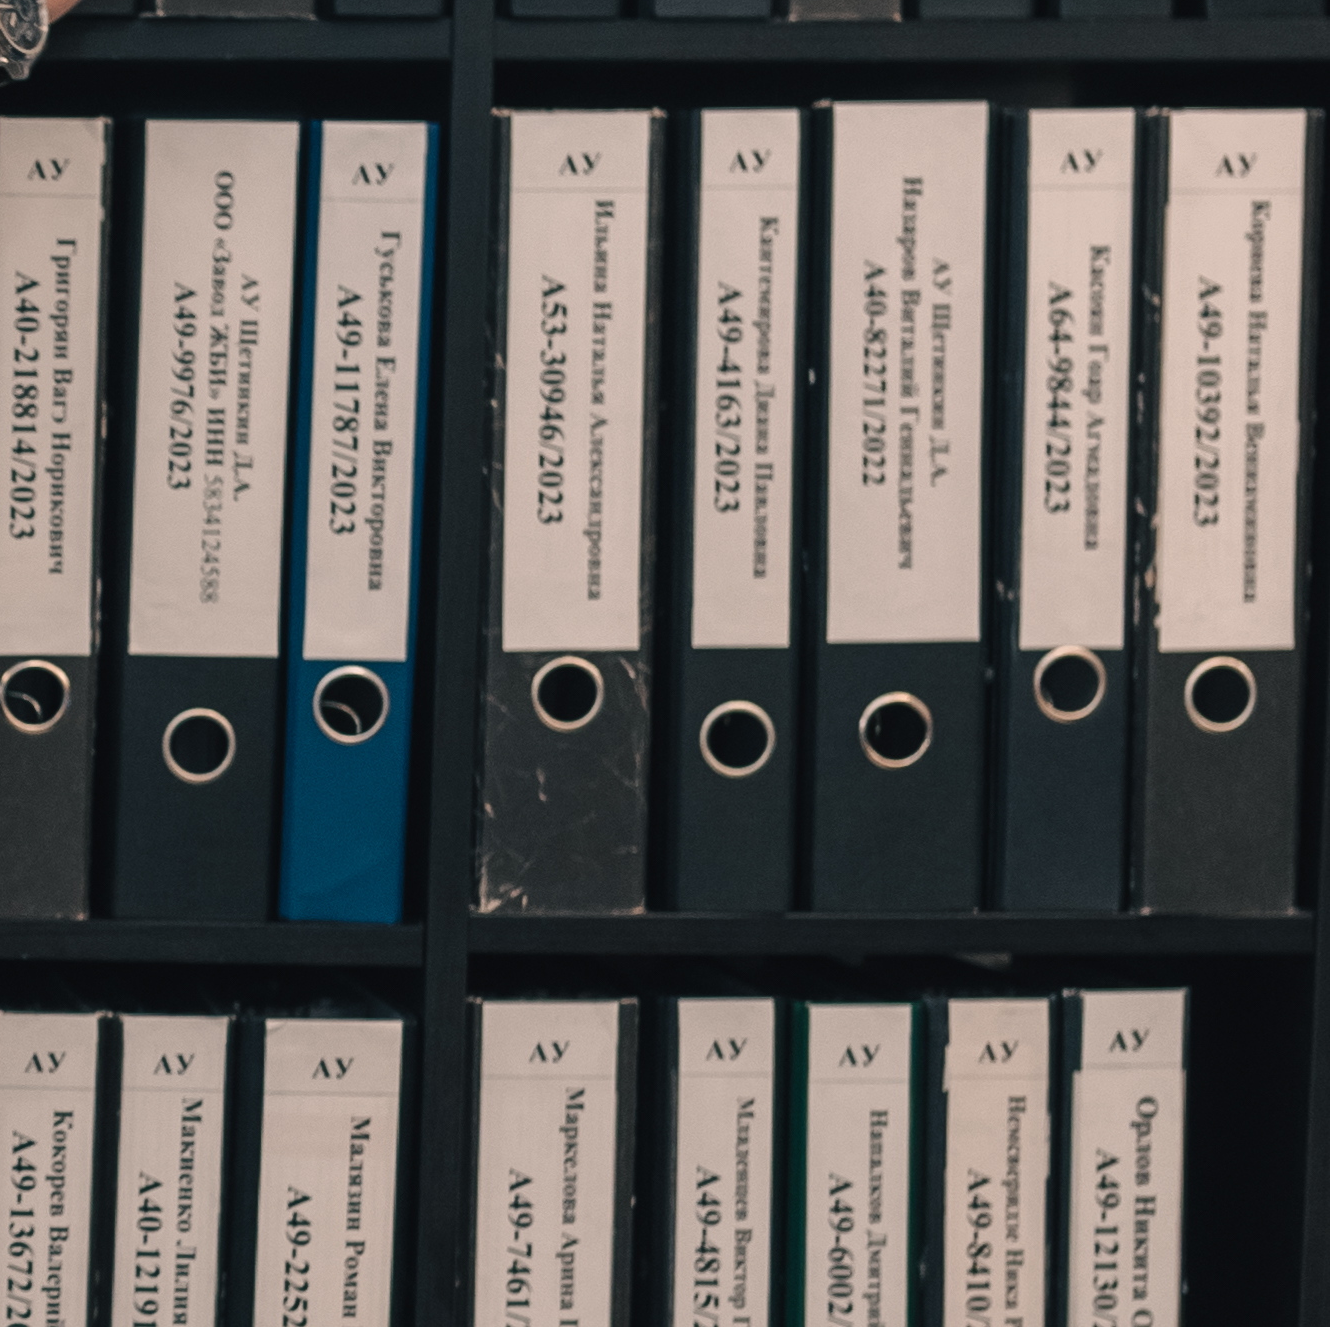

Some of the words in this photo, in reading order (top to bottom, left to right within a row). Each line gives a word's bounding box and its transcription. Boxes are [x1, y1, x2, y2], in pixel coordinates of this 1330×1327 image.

[25, 158, 70, 183] АУ
[350, 161, 395, 187] АУ
[557, 150, 603, 178] АУ
[728, 148, 771, 175] АУ
[1059, 148, 1103, 175] АУ
[1214, 151, 1258, 180] АУ
[592, 199, 615, 294] Ильина
[47, 238, 77, 360] Григорян
[240, 275, 261, 307] АУ
[370, 231, 402, 348] Гуськова
[166, 282, 200, 491] А49-9976/2023
[372, 356, 397, 431] Елена
[590, 301, 613, 406] Наталья
[8, 271, 43, 540] А40-218814/2023
[327, 285, 366, 536] А49-11787/2023
[535, 274, 570, 526] А53-30946/2023
[42, 432, 72, 575] Норикович
[361, 439, 394, 592] Викторовна
[581, 414, 609, 601] Александровна
[25, 1051, 67, 1075] АУ
[153, 1052, 195, 1077] АУ
[311, 1056, 355, 1081] АУ
[529, 1040, 571, 1064] АУ
[705, 1037, 748, 1062] АУ
[838, 1043, 880, 1068] АУ
[977, 1040, 1019, 1064] АУ
[1108, 1028, 1150, 1053] АУ
[43, 1110, 75, 1217] Кокорев
[176, 1099, 204, 1234] Макиенко
[346, 1117, 372, 1231] Малязин
[556, 1087, 586, 1225] Маркелова
[1128, 1095, 1159, 1187] Орлов
[172, 1240, 198, 1326] Лилия
[342, 1240, 366, 1319] Роман
[553, 1234, 580, 1311] Арина
[1131, 1195, 1157, 1301] Никита
